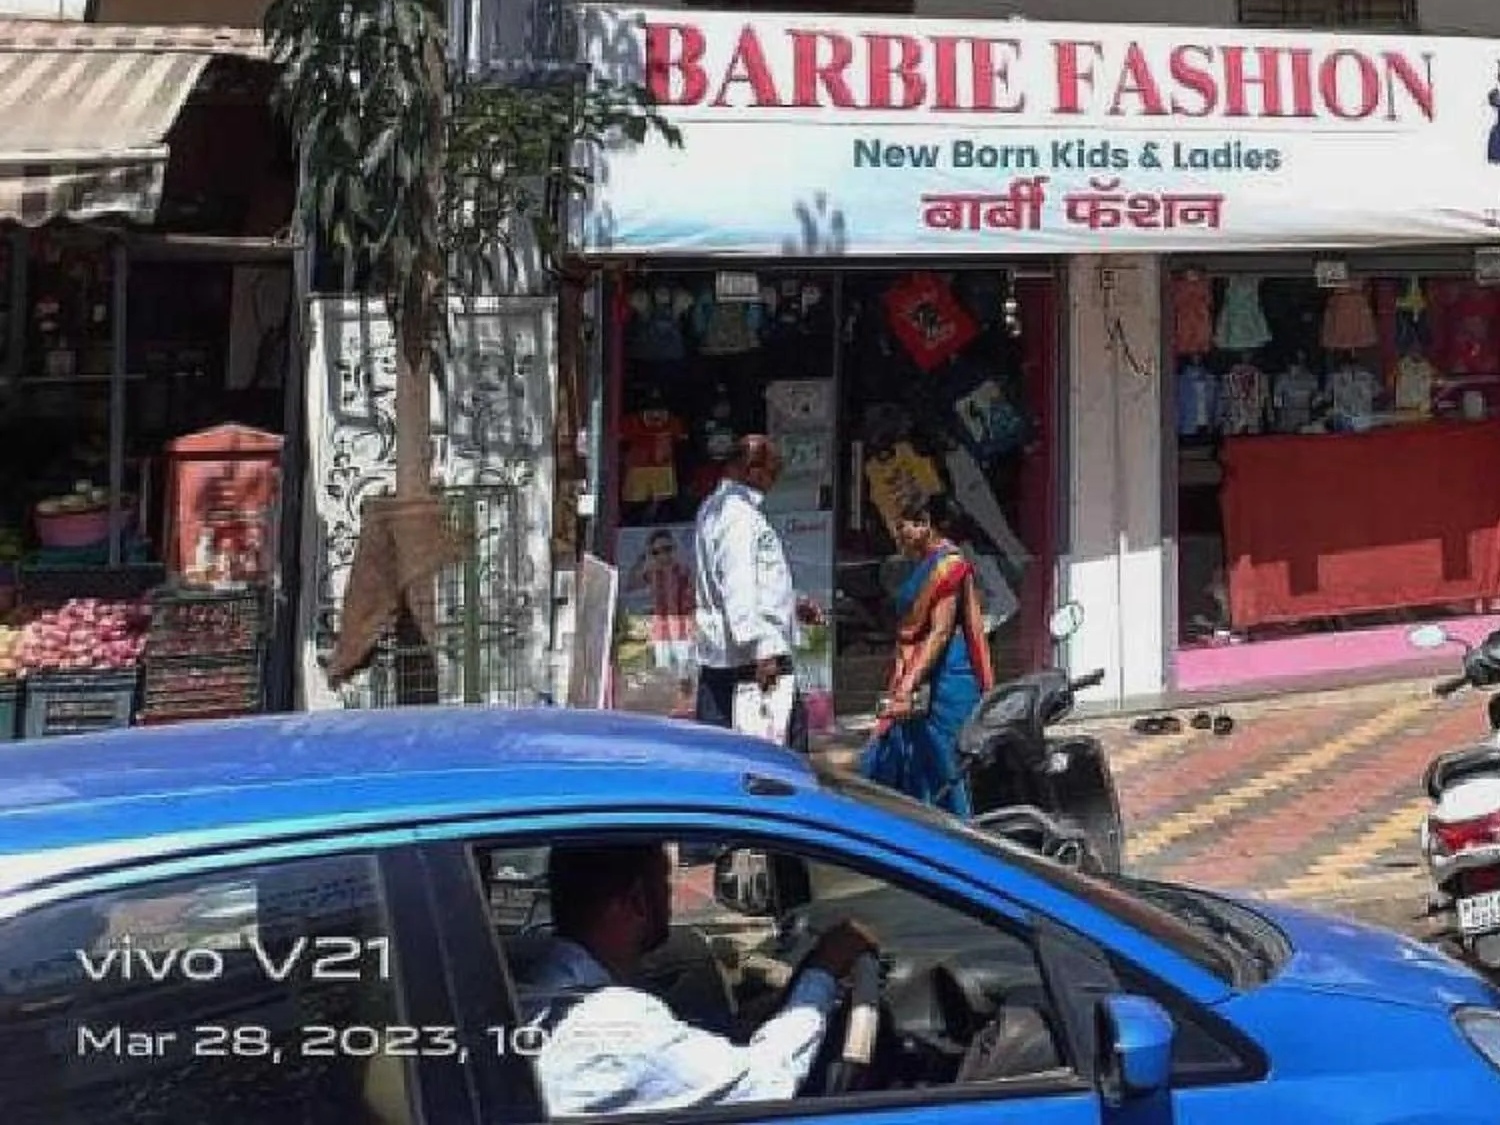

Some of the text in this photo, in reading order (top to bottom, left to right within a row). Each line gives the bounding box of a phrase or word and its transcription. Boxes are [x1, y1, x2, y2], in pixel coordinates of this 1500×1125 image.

[642, 22, 1435, 123] BARBIE FASHION
[853, 139, 1282, 172] New Born Kids & Ladies
[922, 177, 1050, 231] बार्बी
